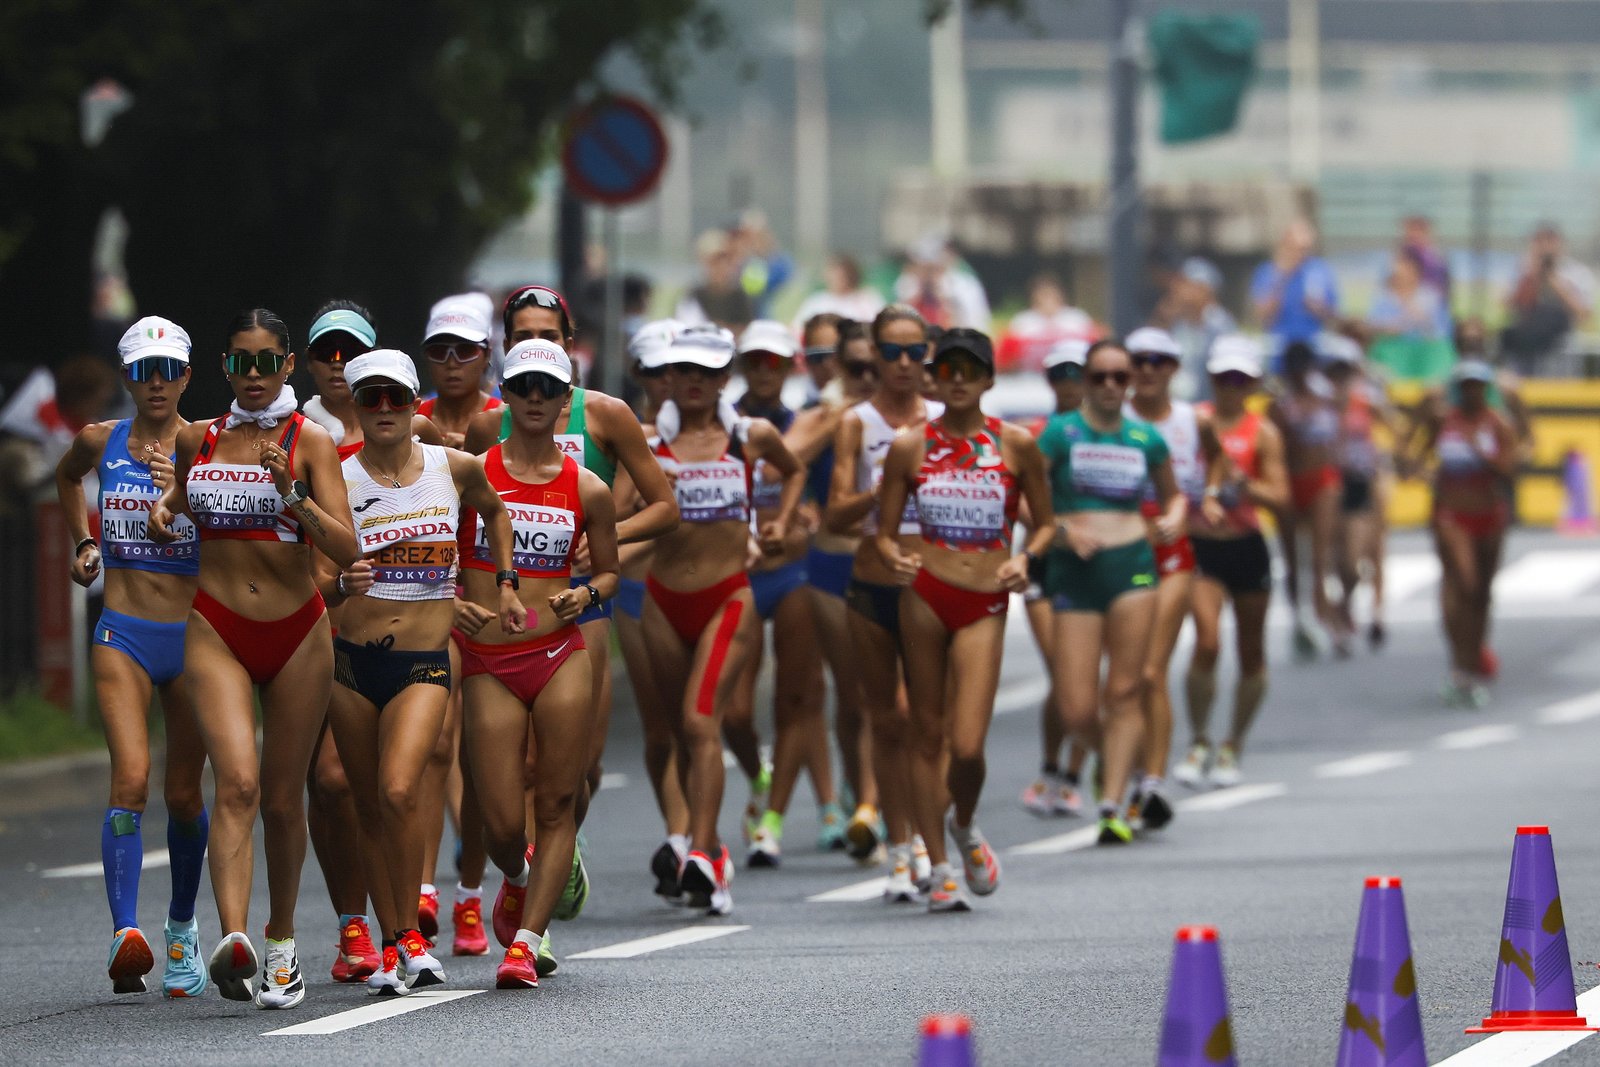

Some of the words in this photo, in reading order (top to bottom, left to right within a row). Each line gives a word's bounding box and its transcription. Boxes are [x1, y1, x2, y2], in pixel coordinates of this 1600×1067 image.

[520, 350, 557, 363] CHINA
[189, 469, 275, 484] HONDA
[678, 468, 740, 481] ONDA
[189, 489, 222, 511] GARCÍA
[225, 490, 255, 513] LEÓN
[258, 498, 275, 513] 163
[921, 487, 1000, 501] HONDA
[104, 497, 157, 512] HON
[505, 508, 572, 527] ONDA
[362, 522, 454, 546] HONDA
[553, 539, 569, 554] 112
[380, 546, 435, 565] EREZ
